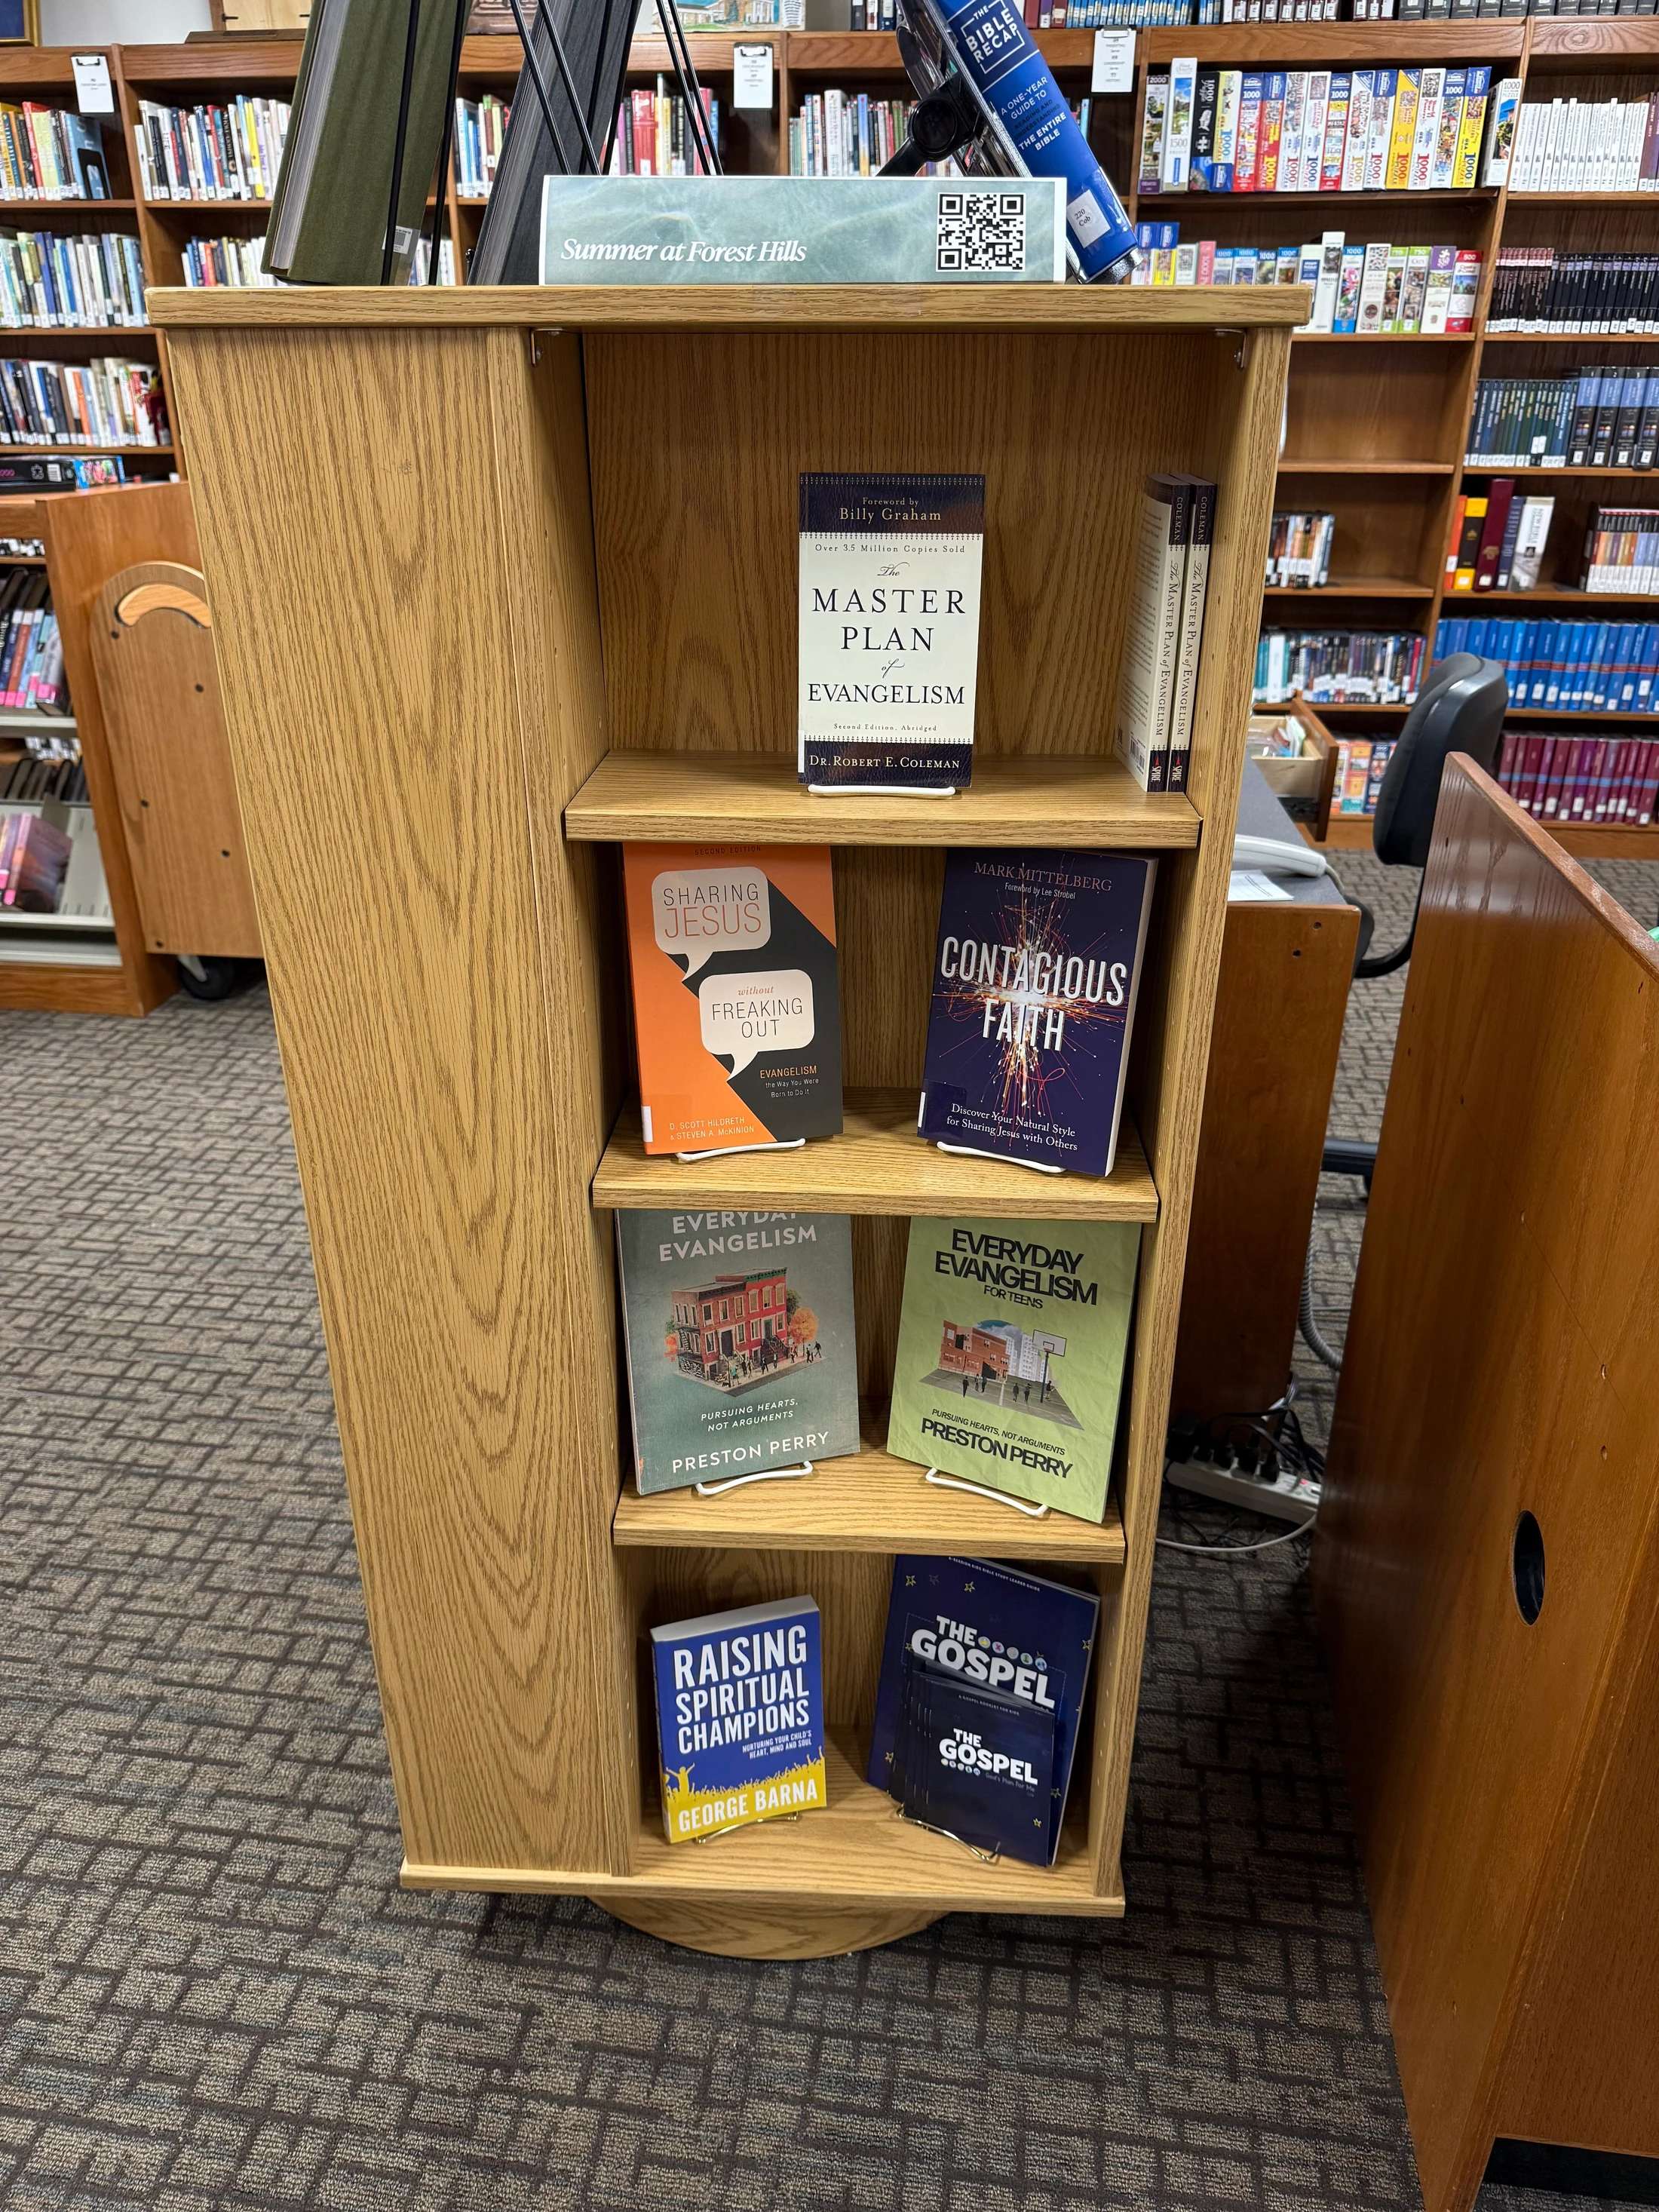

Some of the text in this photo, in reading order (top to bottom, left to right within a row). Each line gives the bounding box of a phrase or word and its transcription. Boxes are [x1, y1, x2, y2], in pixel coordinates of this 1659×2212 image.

[974, 5, 989, 20] THE
[965, 8, 1014, 52] BIBLE
[973, 23, 1018, 63] RECAP
[1007, 76, 1048, 109] ONE-YEAR
[1207, 79, 1216, 102] 1000
[1243, 91, 1260, 99] 1000
[1331, 91, 1348, 99] 1000
[1445, 86, 1463, 94] 1000
[1504, 81, 1520, 90] 1000
[1010, 90, 1047, 119] GUIDE TO
[1018, 112, 1066, 150] THE ENTIRE
[1035, 129, 1060, 151] BIBLE
[1170, 138, 1188, 147] 1500
[1220, 129, 1232, 156] 1000
[1264, 155, 1277, 183] 1000
[1287, 156, 1299, 183] 1000
[1307, 155, 1319, 183] 1000
[1352, 155, 1363, 183] 1000
[1371, 152, 1382, 179] 1000
[1397, 152, 1409, 179] 1000
[1418, 153, 1430, 180] 1000
[1464, 152, 1477, 179] 1000
[1074, 208, 1085, 219] 220
[1078, 216, 1091, 226] Cob
[560, 238, 807, 262] Summer at Forest Hills
[1259, 252, 1276, 260] 1000
[863, 497, 919, 507] Foreword by
[839, 508, 942, 524] Billy Graham
[1173, 497, 1183, 541] COLEMAN
[1197, 496, 1207, 541] COLEMAN
[815, 544, 839, 552] Over
[843, 544, 855, 552] 3.5
[860, 544, 898, 552] Million
[903, 545, 938, 554] Copies
[877, 561, 910, 577] The
[1169, 560, 1181, 589] The
[1192, 560, 1204, 589] The
[811, 588, 966, 614] MASTER
[841, 626, 934, 652] PLAN
[881, 658, 906, 679] of
[1160, 659, 1169, 668] of
[1182, 658, 1191, 667] of
[808, 683, 965, 704] EVANGELISM
[885, 756, 897, 767] E.
[1151, 765, 1162, 783] SPIRE
[1171, 765, 1182, 782] SPIRE
[730, 845, 762, 854] EDITION
[974, 861, 1112, 891] MARK MITTELBERG
[663, 882, 759, 907] SHARING
[1004, 882, 1076, 900] Foreword by Lee Strobel
[664, 902, 762, 938] JESUS
[940, 936, 1127, 1006] CONTAGIOUS
[738, 986, 774, 996] without
[712, 997, 803, 1020] FREAKING
[741, 1019, 780, 1039] OUT
[983, 998, 1066, 1052] FAITH
[759, 1065, 817, 1078] EVANGELISM
[776, 1080, 790, 1088] Way
[676, 1131, 706, 1140] STEVEN
[718, 1125, 754, 1135] McKINION
[679, 1120, 705, 1129] SCOTT
[707, 1116, 745, 1127] HILDRETH
[951, 1103, 1076, 1138] Discover Your Natural Style
[946, 1116, 1078, 1151] for Sharing Jesus with Others
[659, 1224, 817, 1262] EVANGELISM
[952, 1228, 1085, 1275] EVERYDAY
[935, 1250, 1098, 1306] EVANGELISM
[983, 1284, 1044, 1309] FOR TEENS
[701, 1398, 799, 1422] PURSUING HEARTS,
[707, 1410, 794, 1432] NOT ARGUMENTS
[931, 1408, 1066, 1456] PURSUING HEARTS, NOT ARGUMENTS
[672, 1431, 829, 1474] PRESTON PERRY
[921, 1417, 1074, 1479] PRESTON PERRY
[995, 1572, 1009, 1581] STUDY
[1009, 1577, 1026, 1586] LEADER
[1026, 1583, 1040, 1592] GUIDE
[936, 1615, 978, 1646] THE
[673, 1624, 807, 1690] RAISING
[910, 1628, 1056, 1710] GOSPEL
[676, 1667, 809, 1725] SPIRITUAL
[962, 1695, 980, 1704] GOSPEL
[677, 1698, 810, 1754] CHAMPIONS
[952, 1728, 982, 1748] THE
[742, 1729, 812, 1753] NURTURING YOUR CHILD'S
[749, 1738, 812, 1759] HEART, MIND AND SOUL
[939, 1738, 1038, 1785] GOSPEL
[985, 1772, 1035, 1792] God's Plan Me
[678, 1778, 818, 1833] GEORGE BARNA
